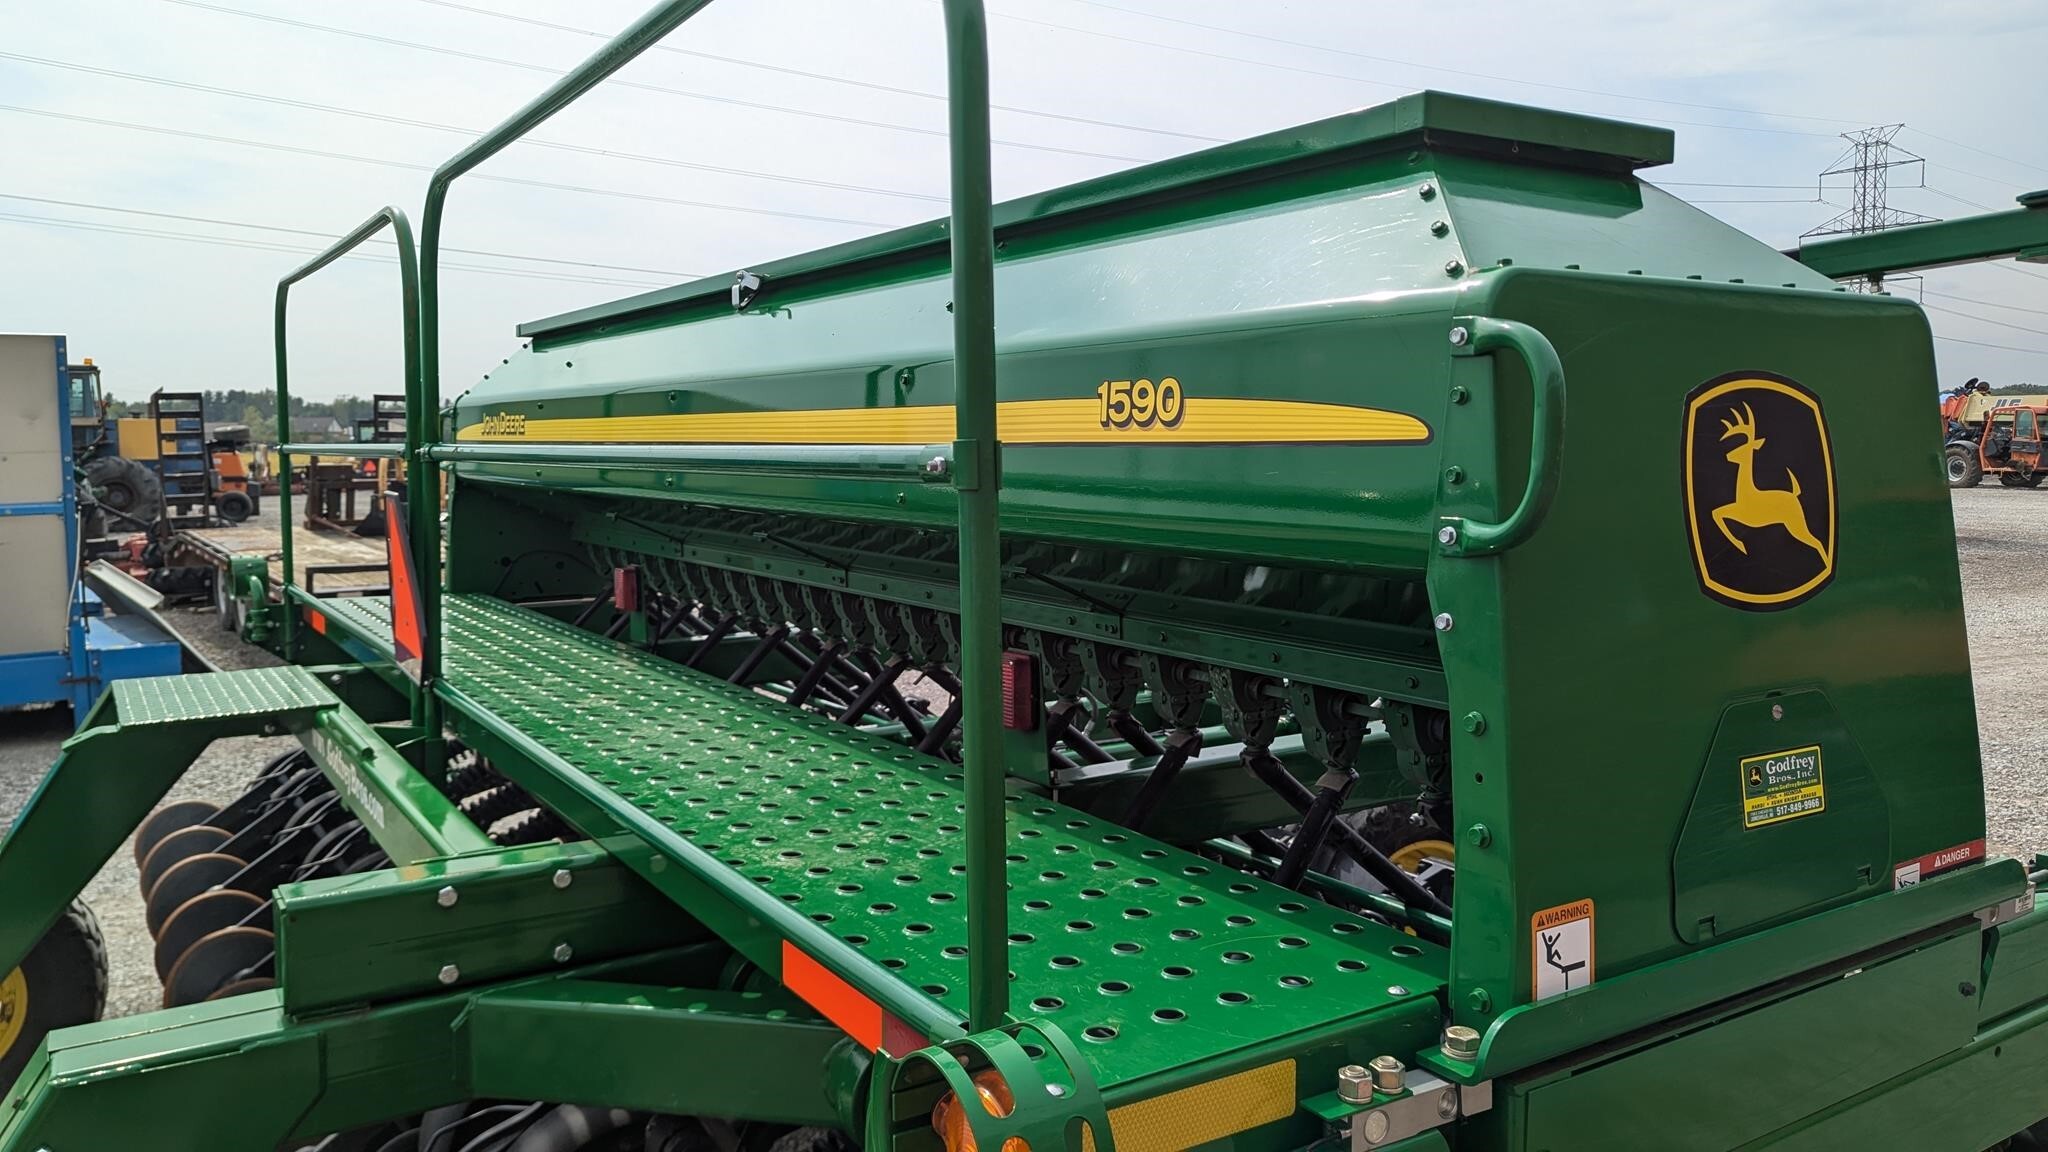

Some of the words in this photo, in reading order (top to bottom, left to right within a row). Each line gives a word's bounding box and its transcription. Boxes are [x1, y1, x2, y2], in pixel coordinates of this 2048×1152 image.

[1097, 377, 1184, 428] 1590
[1766, 755, 1815, 775] Godfrey
[1796, 769, 1815, 779] Inc.
[1941, 847, 1970, 865] DANGER
[1545, 903, 1590, 925] WARNING
